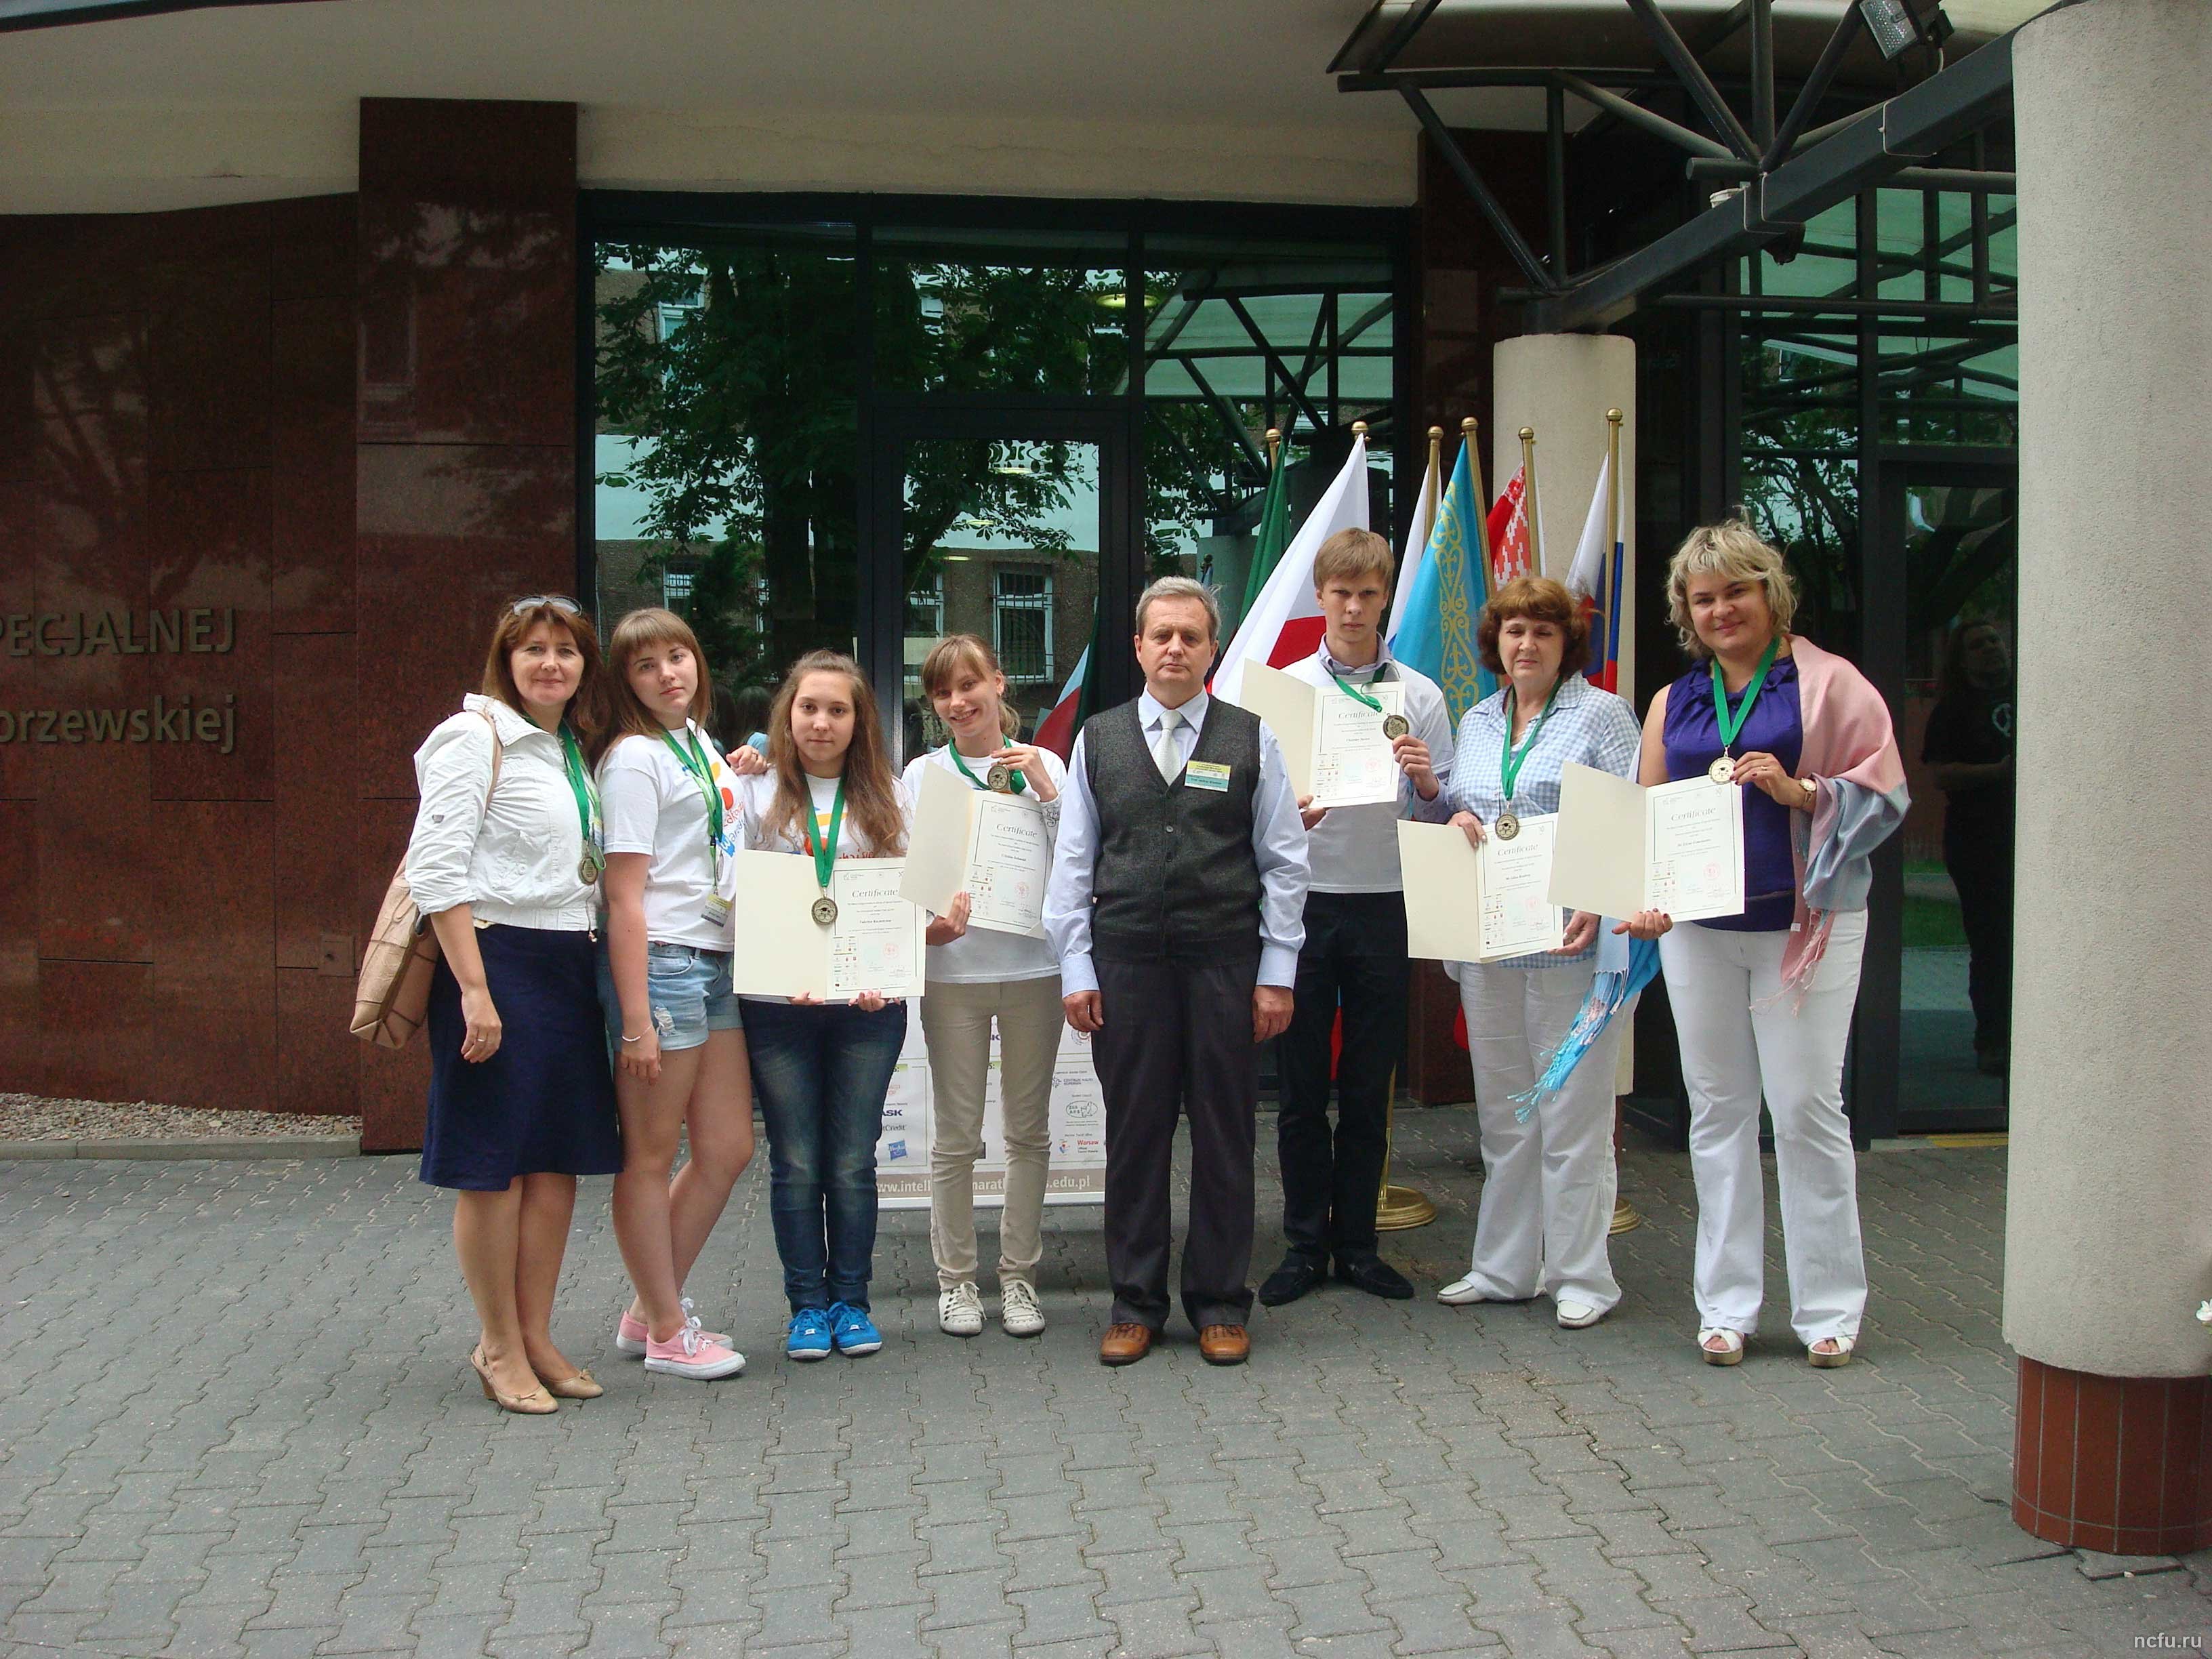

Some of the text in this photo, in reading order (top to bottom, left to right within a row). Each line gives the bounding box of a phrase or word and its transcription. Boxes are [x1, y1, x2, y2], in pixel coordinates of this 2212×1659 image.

[0, 607, 234, 657] ECJALNEJ
[1671, 807, 1716, 821] Certificate
[996, 823, 1038, 838] Certificate
[1498, 844, 1538, 856] Certificate
[852, 888, 899, 898] Certificate
